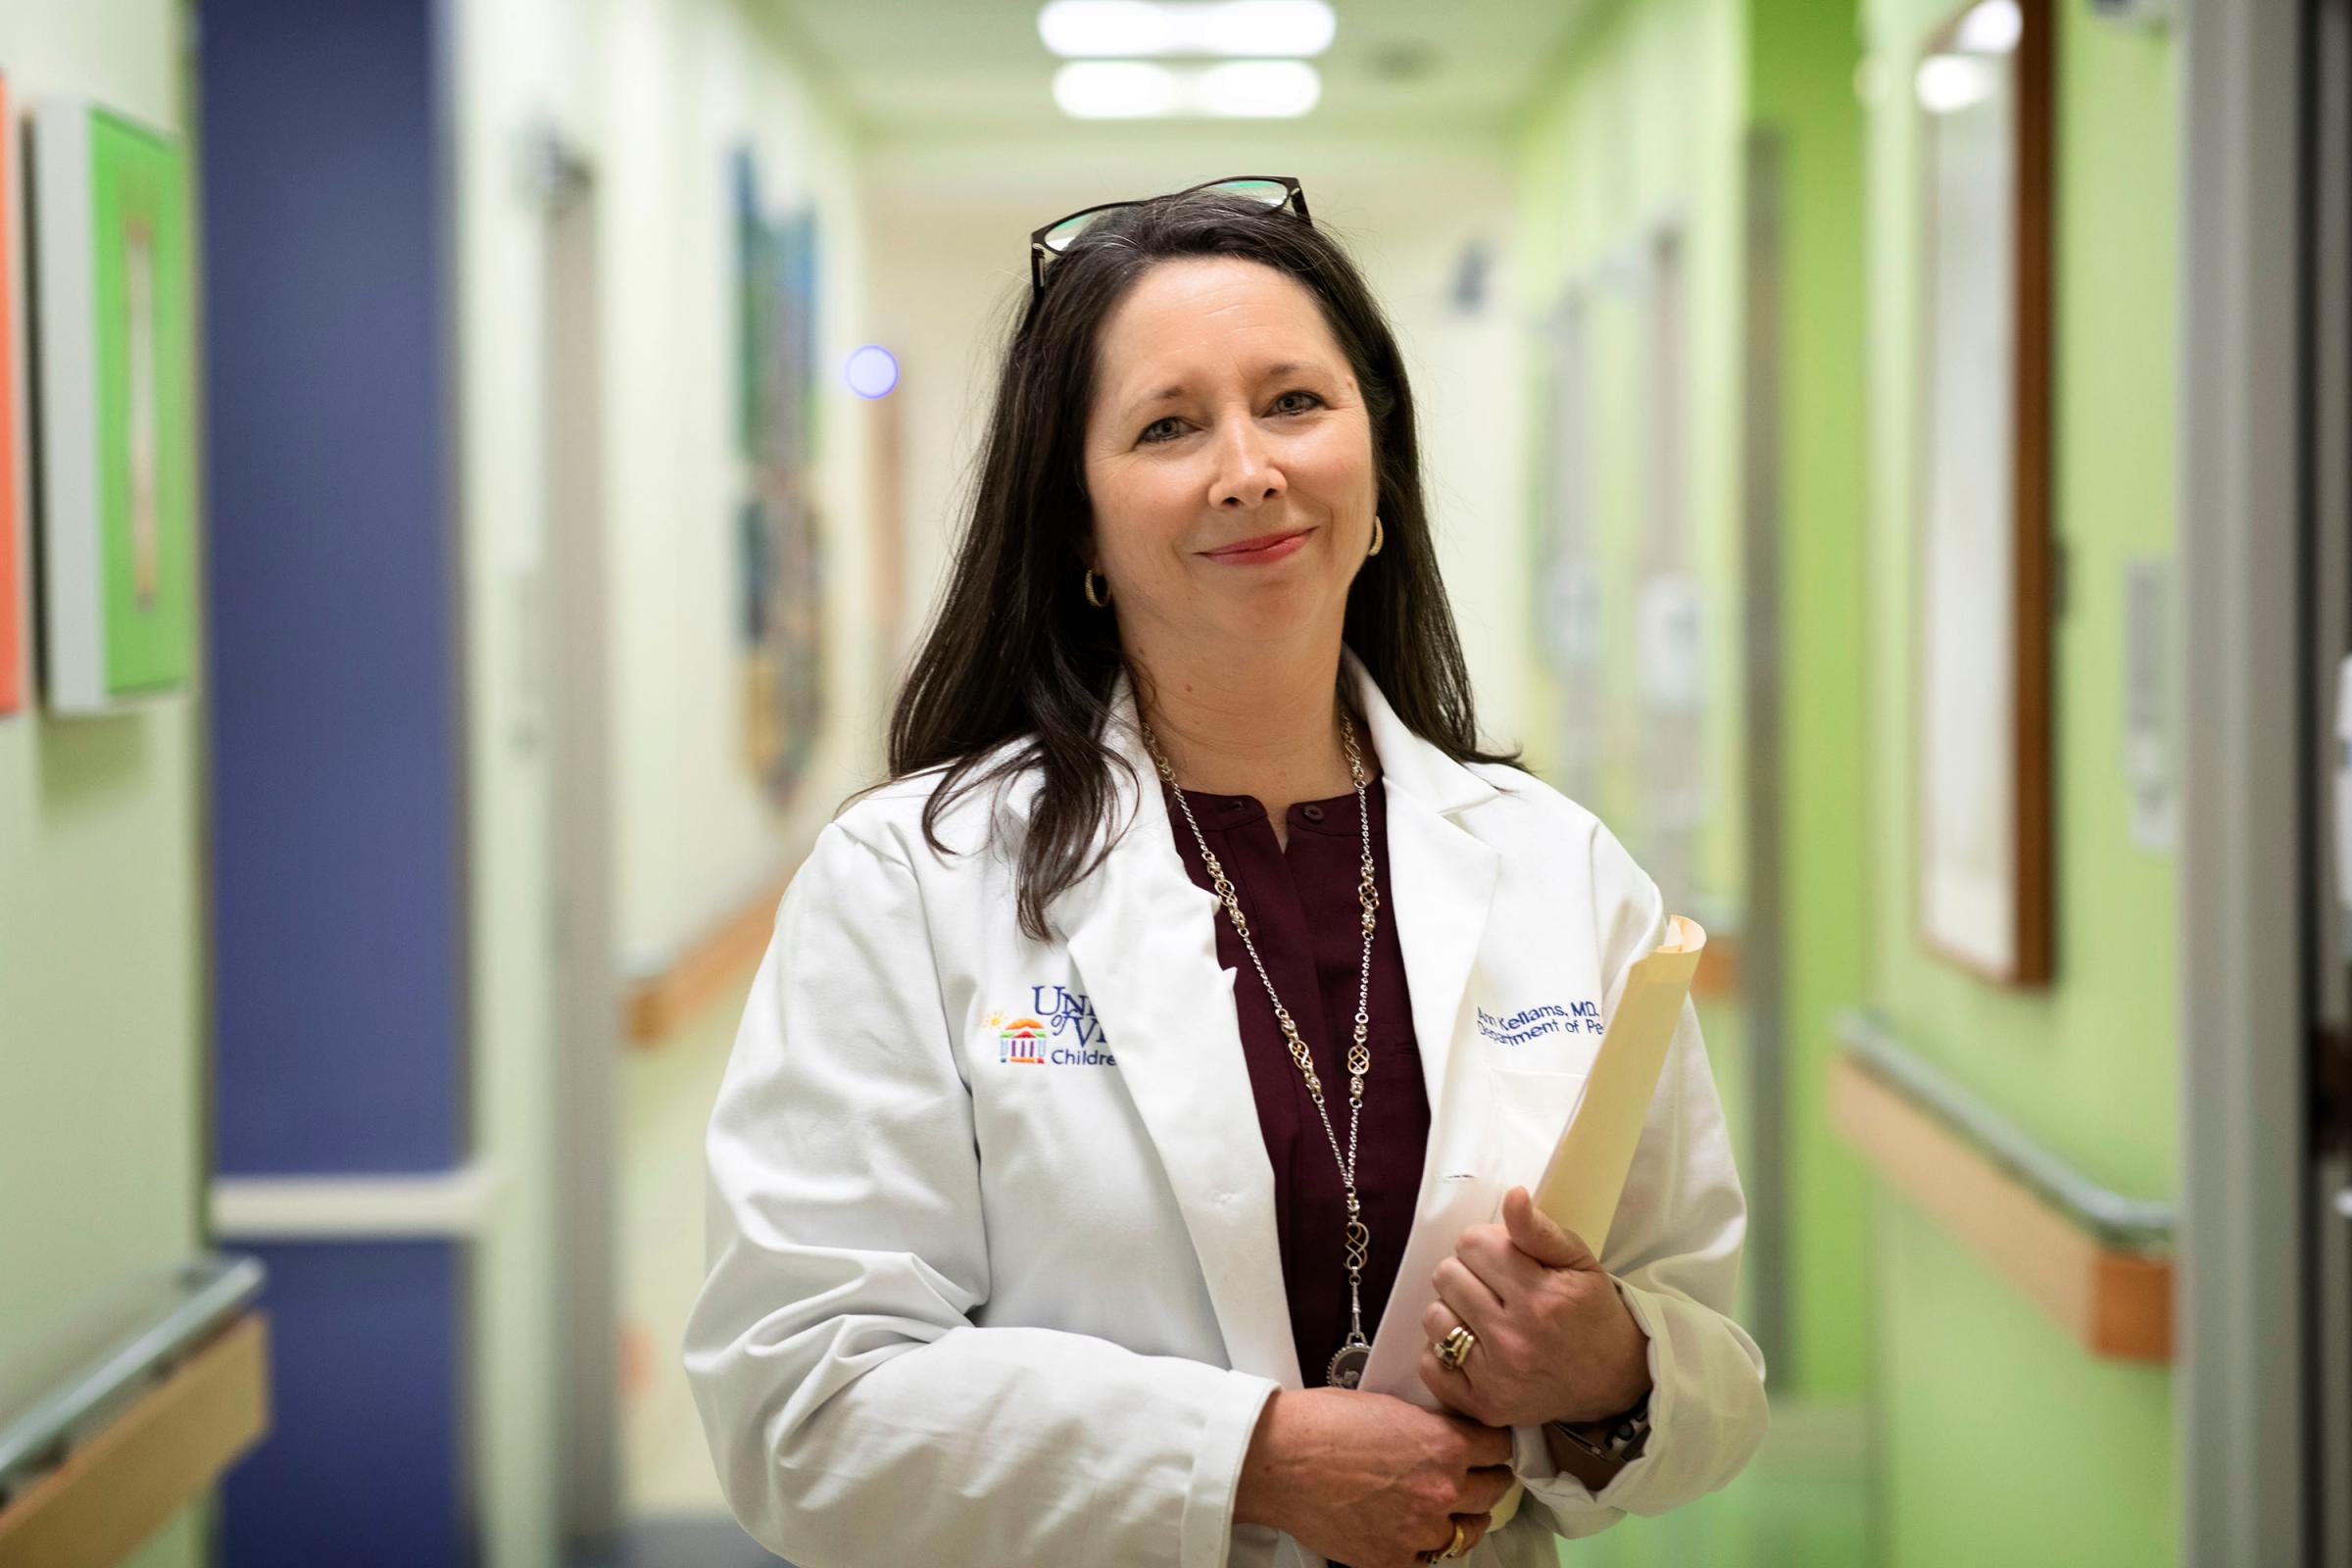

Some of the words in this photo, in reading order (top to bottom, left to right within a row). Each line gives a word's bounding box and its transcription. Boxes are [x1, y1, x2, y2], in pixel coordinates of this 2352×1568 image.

[1565, 1020, 1579, 1034] of
[1587, 1018, 1604, 1036] Pe
[1052, 1049, 1116, 1065] Childre
